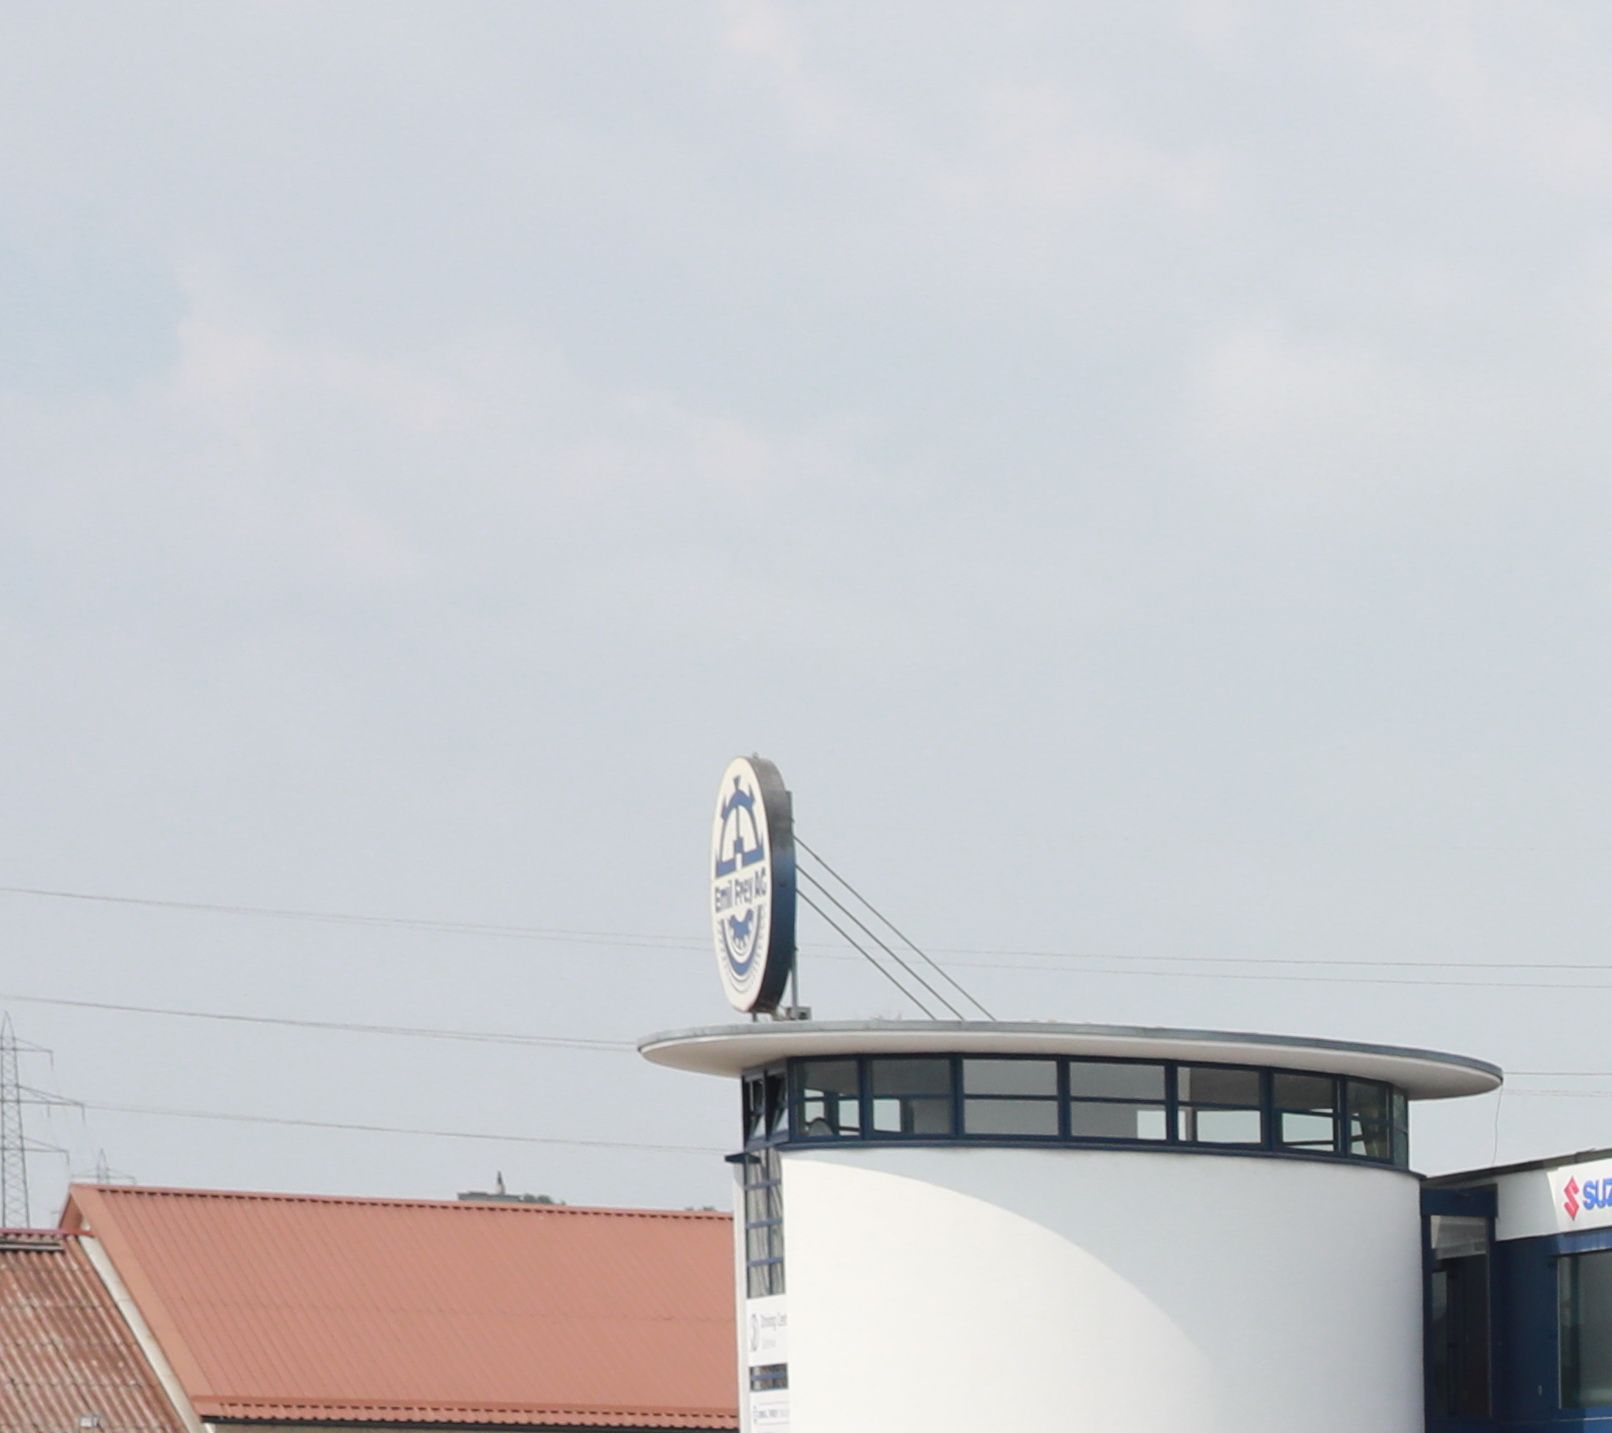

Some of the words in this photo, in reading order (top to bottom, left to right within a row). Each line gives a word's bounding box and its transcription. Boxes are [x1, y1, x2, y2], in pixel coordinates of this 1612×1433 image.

[715, 878, 733, 914] Emil
[734, 876, 754, 906] Frey
[755, 866, 766, 899] AG
